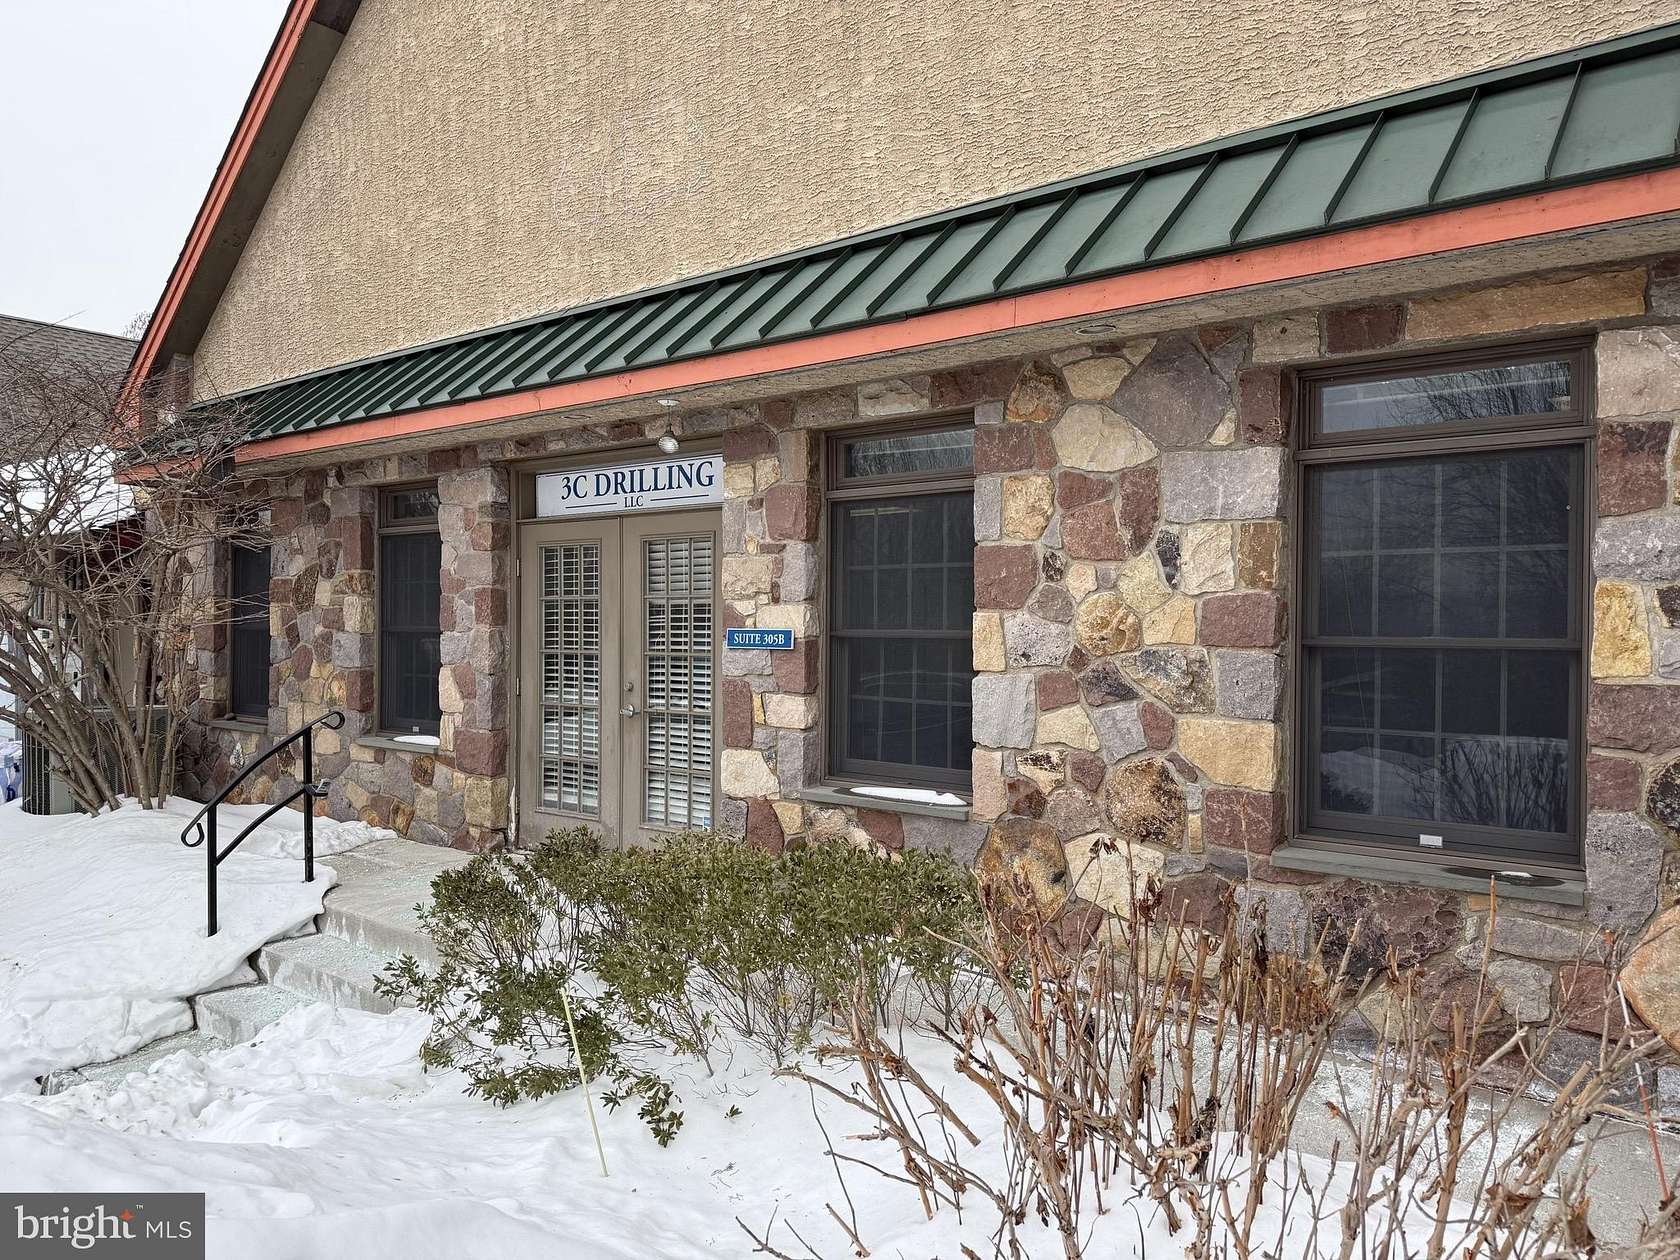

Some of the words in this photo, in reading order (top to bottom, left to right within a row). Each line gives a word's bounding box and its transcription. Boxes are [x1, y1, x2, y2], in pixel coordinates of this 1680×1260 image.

[561, 475, 588, 500] 3C
[594, 460, 714, 497] DRILLING
[624, 495, 644, 508] LLC
[733, 633, 761, 644] SUITE
[762, 633, 785, 645] 305B
